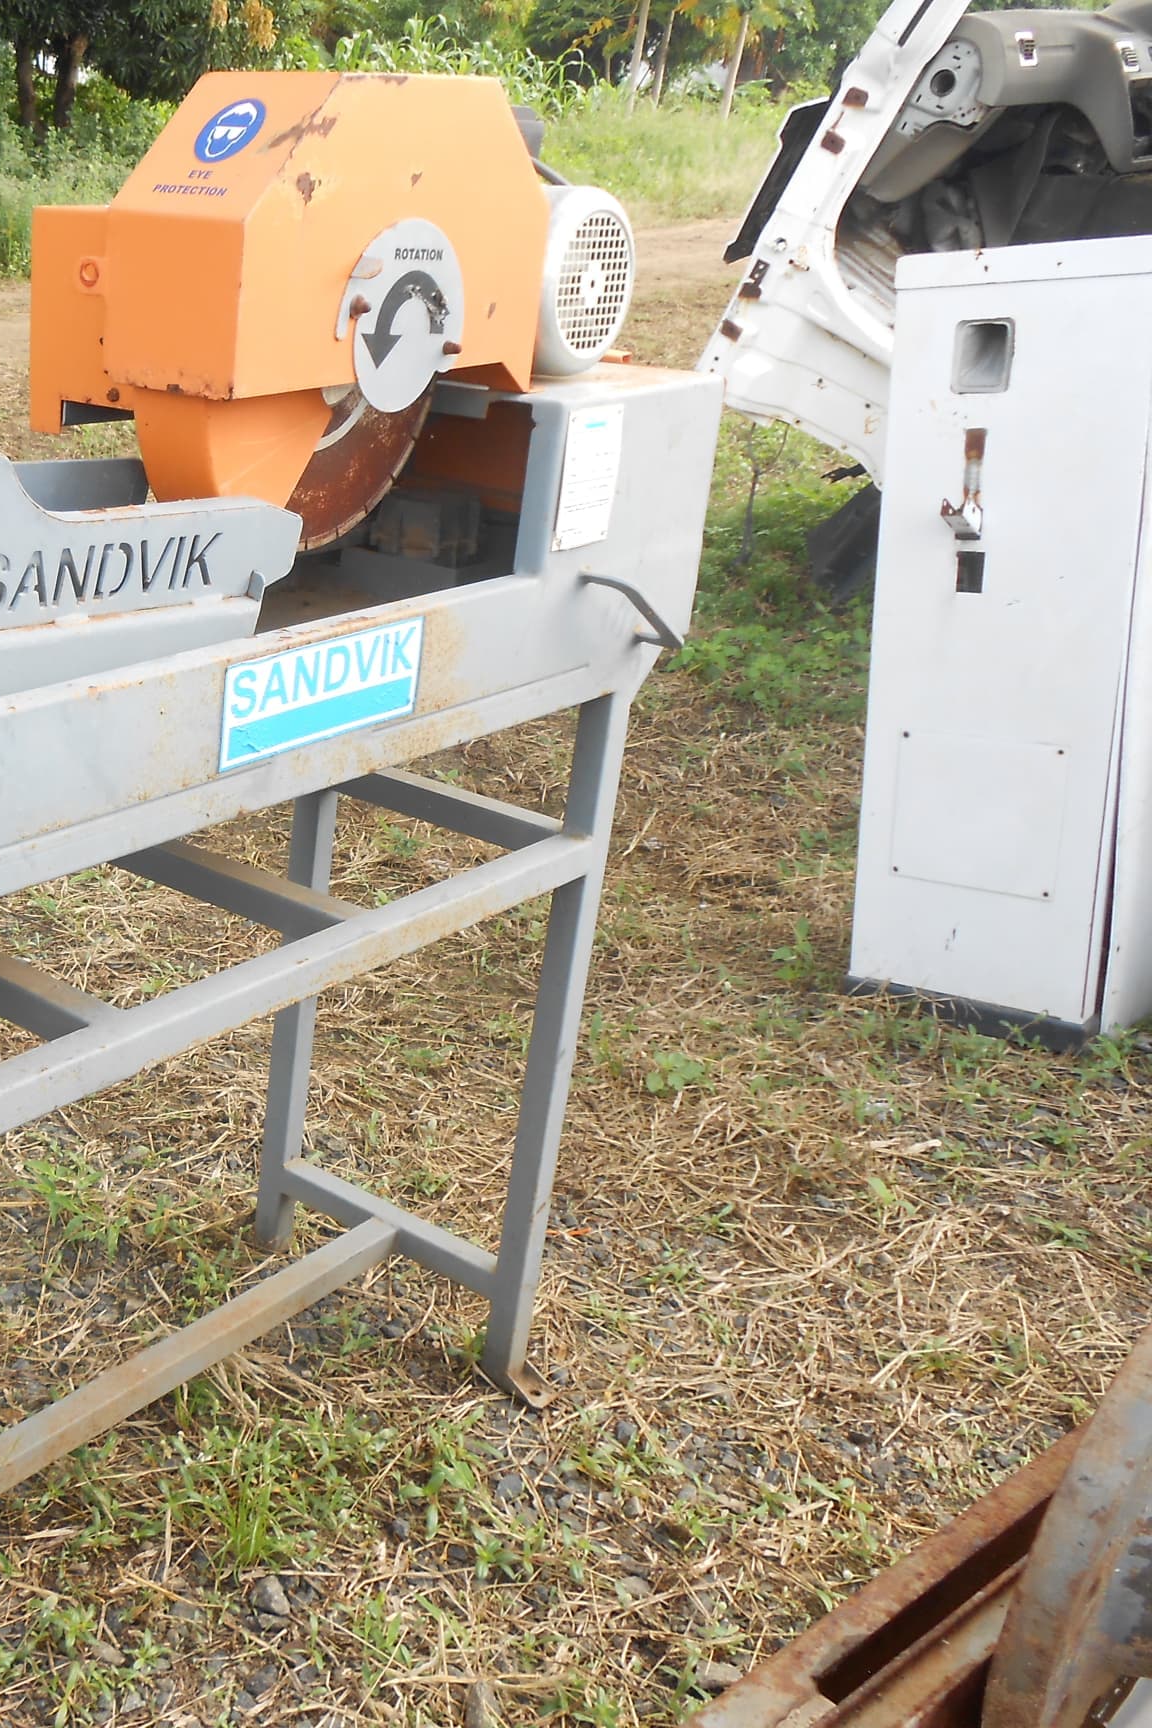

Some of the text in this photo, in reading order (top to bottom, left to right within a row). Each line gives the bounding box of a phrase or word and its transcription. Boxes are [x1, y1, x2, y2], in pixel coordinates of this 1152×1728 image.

[187, 169, 213, 180] EYE
[152, 184, 228, 197] PROTECTION
[394, 248, 444, 261] ROTATION
[230, 626, 417, 719] SANDVIK
